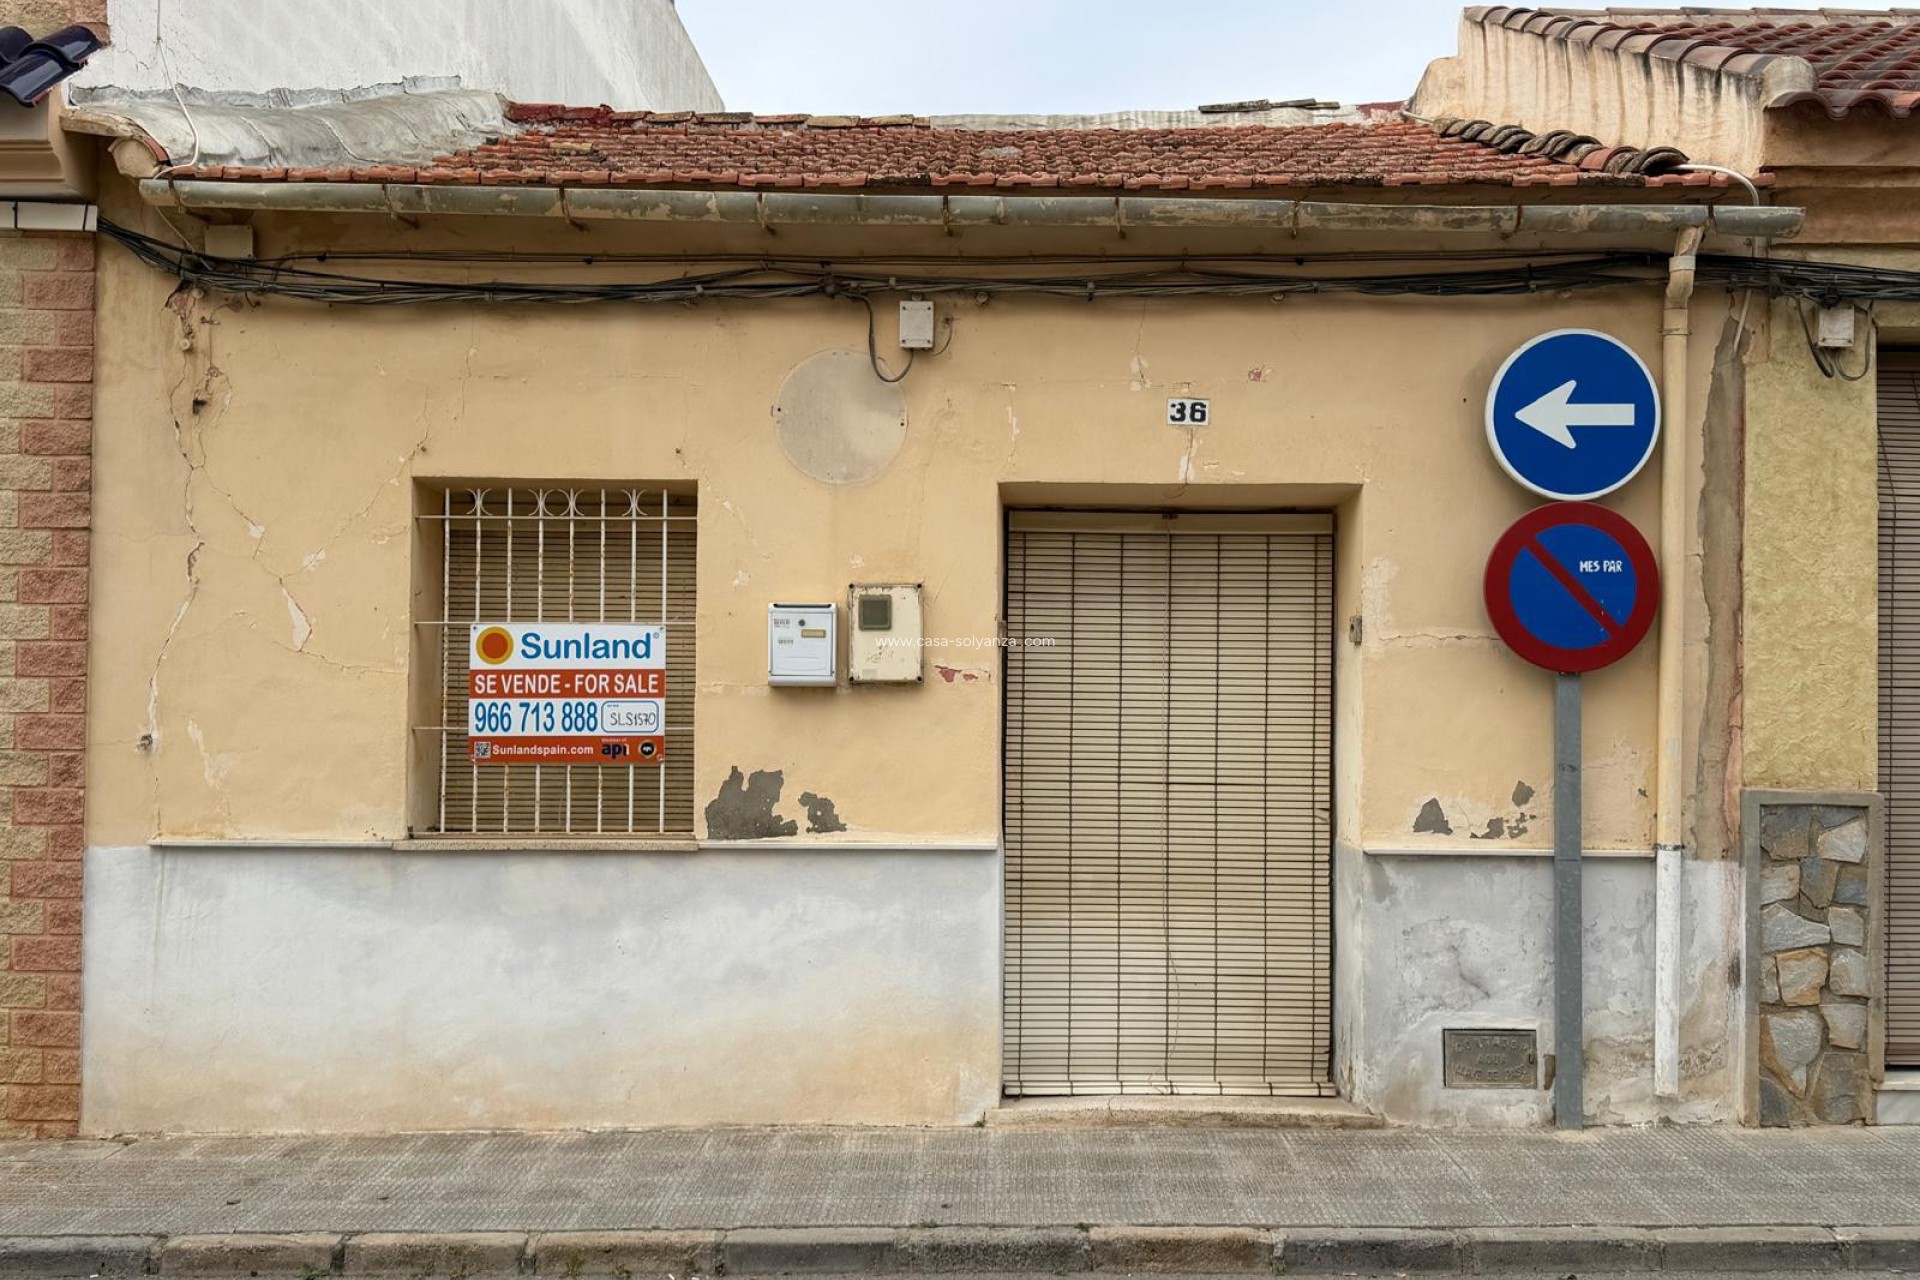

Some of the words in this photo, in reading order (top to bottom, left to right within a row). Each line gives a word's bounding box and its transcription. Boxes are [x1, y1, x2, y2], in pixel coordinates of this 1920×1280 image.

[1170, 402, 1207, 423] 36
[1579, 560, 1600, 573] MES
[1603, 560, 1623, 573] PAR
[521, 632, 652, 660] Sunland
[475, 674, 497, 694] SE
[501, 674, 561, 694] VENDE
[574, 674, 610, 694] FOR
[613, 674, 659, 694] SALE
[474, 701, 512, 733] 966
[519, 701, 555, 733] 713
[561, 701, 598, 733] 888
[610, 712, 656, 726] SLS1570
[492, 745, 594, 757] Sunlandspain.com
